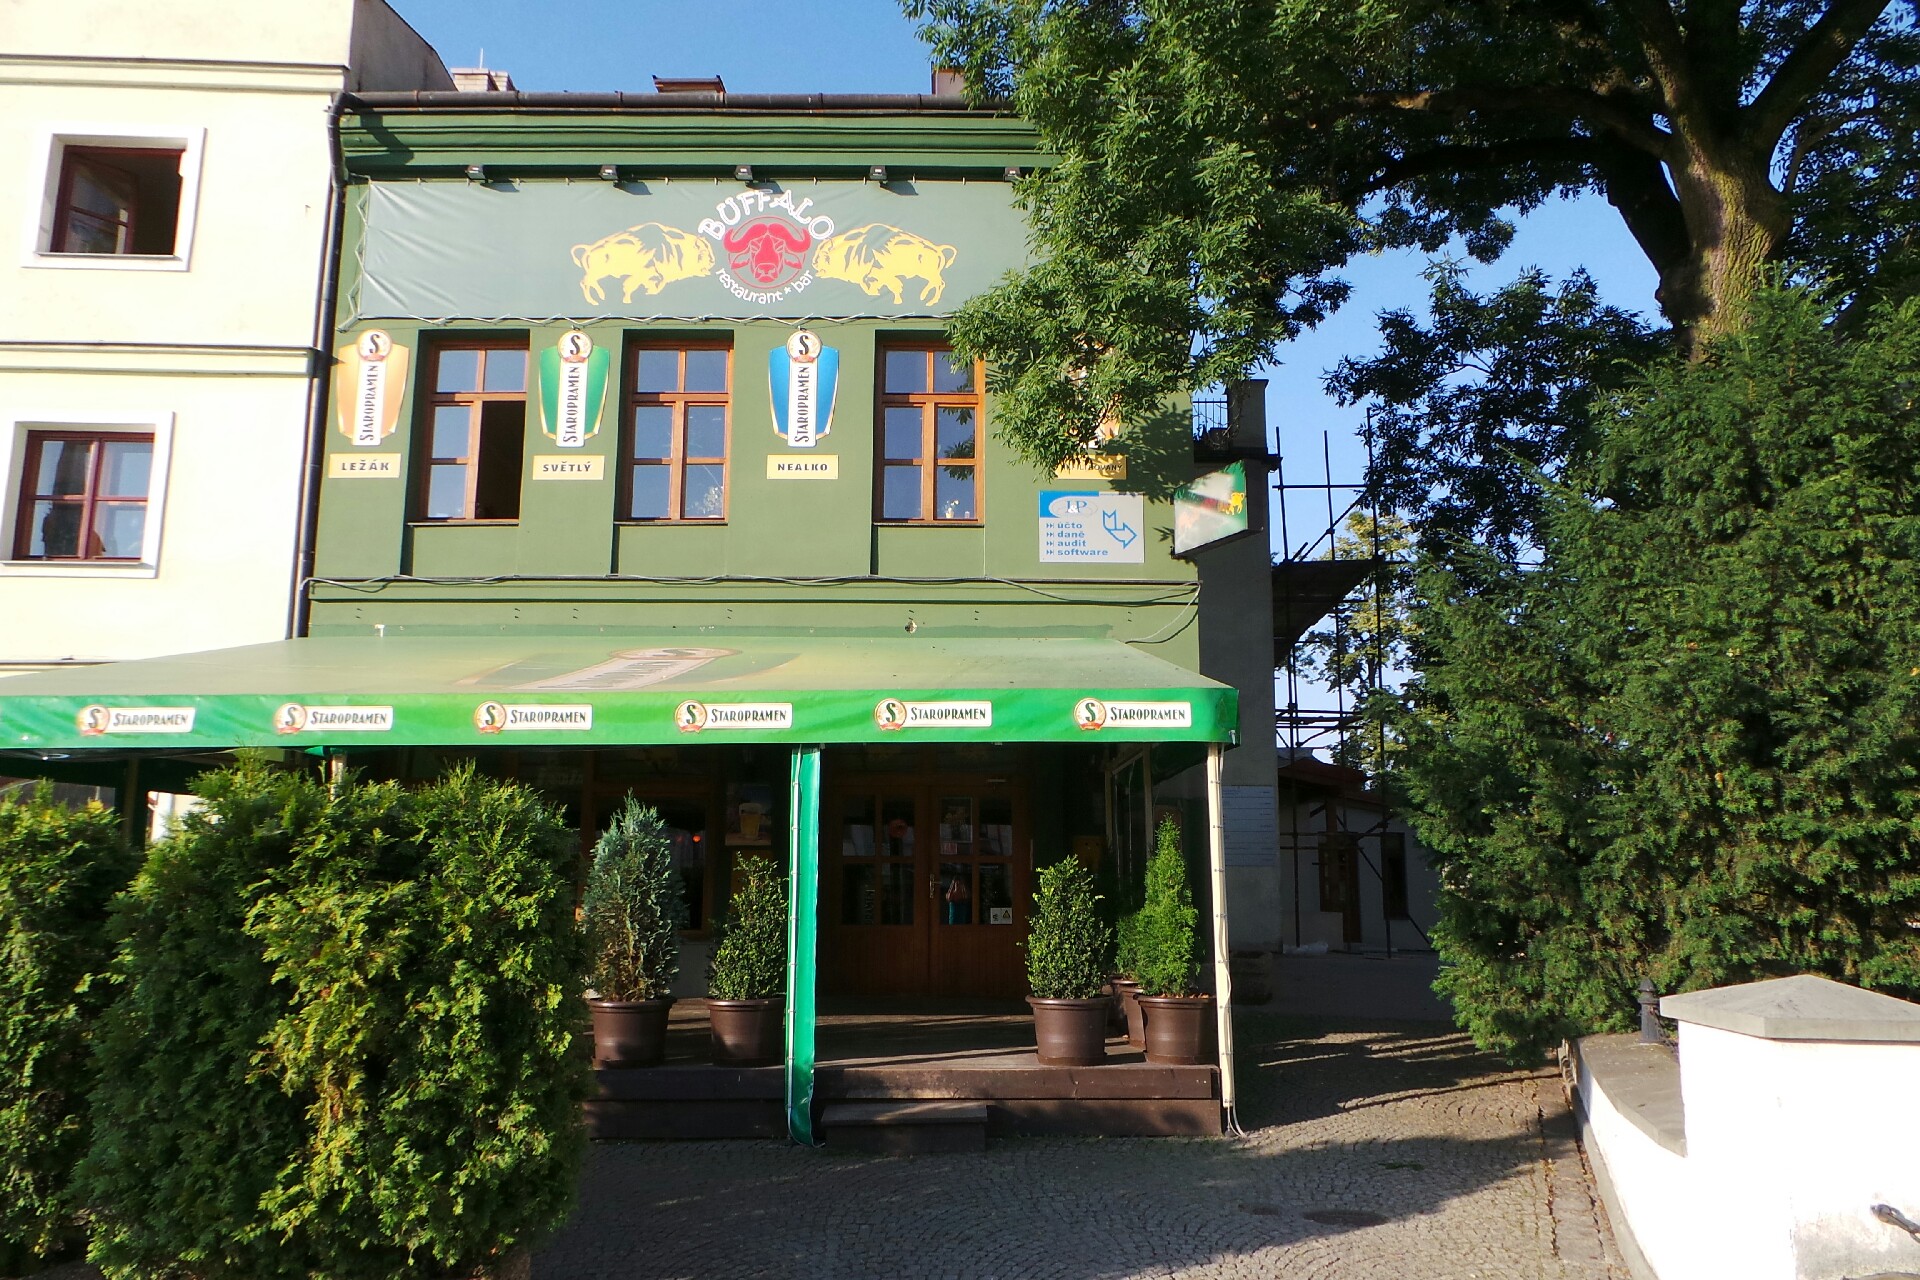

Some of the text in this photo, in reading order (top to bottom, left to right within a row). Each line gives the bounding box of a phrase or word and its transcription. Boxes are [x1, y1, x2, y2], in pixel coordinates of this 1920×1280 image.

[698, 189, 835, 240] BUFFALO
[715, 268, 814, 304] restaurant bar
[369, 334, 380, 354] S
[569, 335, 581, 355] S
[798, 335, 809, 355] S
[360, 365, 378, 441] STAROPRAMEN
[563, 366, 580, 442] STAROPRAMEN
[794, 366, 810, 442] STAROPRAMEN
[341, 459, 389, 471] LEŽÁK
[543, 461, 591, 472] SVĚTLÝ
[777, 463, 828, 471] NEALKO
[88, 709, 188, 728] S STAROPRAMEN
[285, 707, 387, 726] S STAROPRAMEN
[485, 705, 586, 725] S STAROPRAMEN
[685, 704, 787, 724] S STAROPRAMEN
[885, 703, 986, 722] S STAROPRAMEN
[1085, 702, 1186, 722] S STAROPRAMEN
